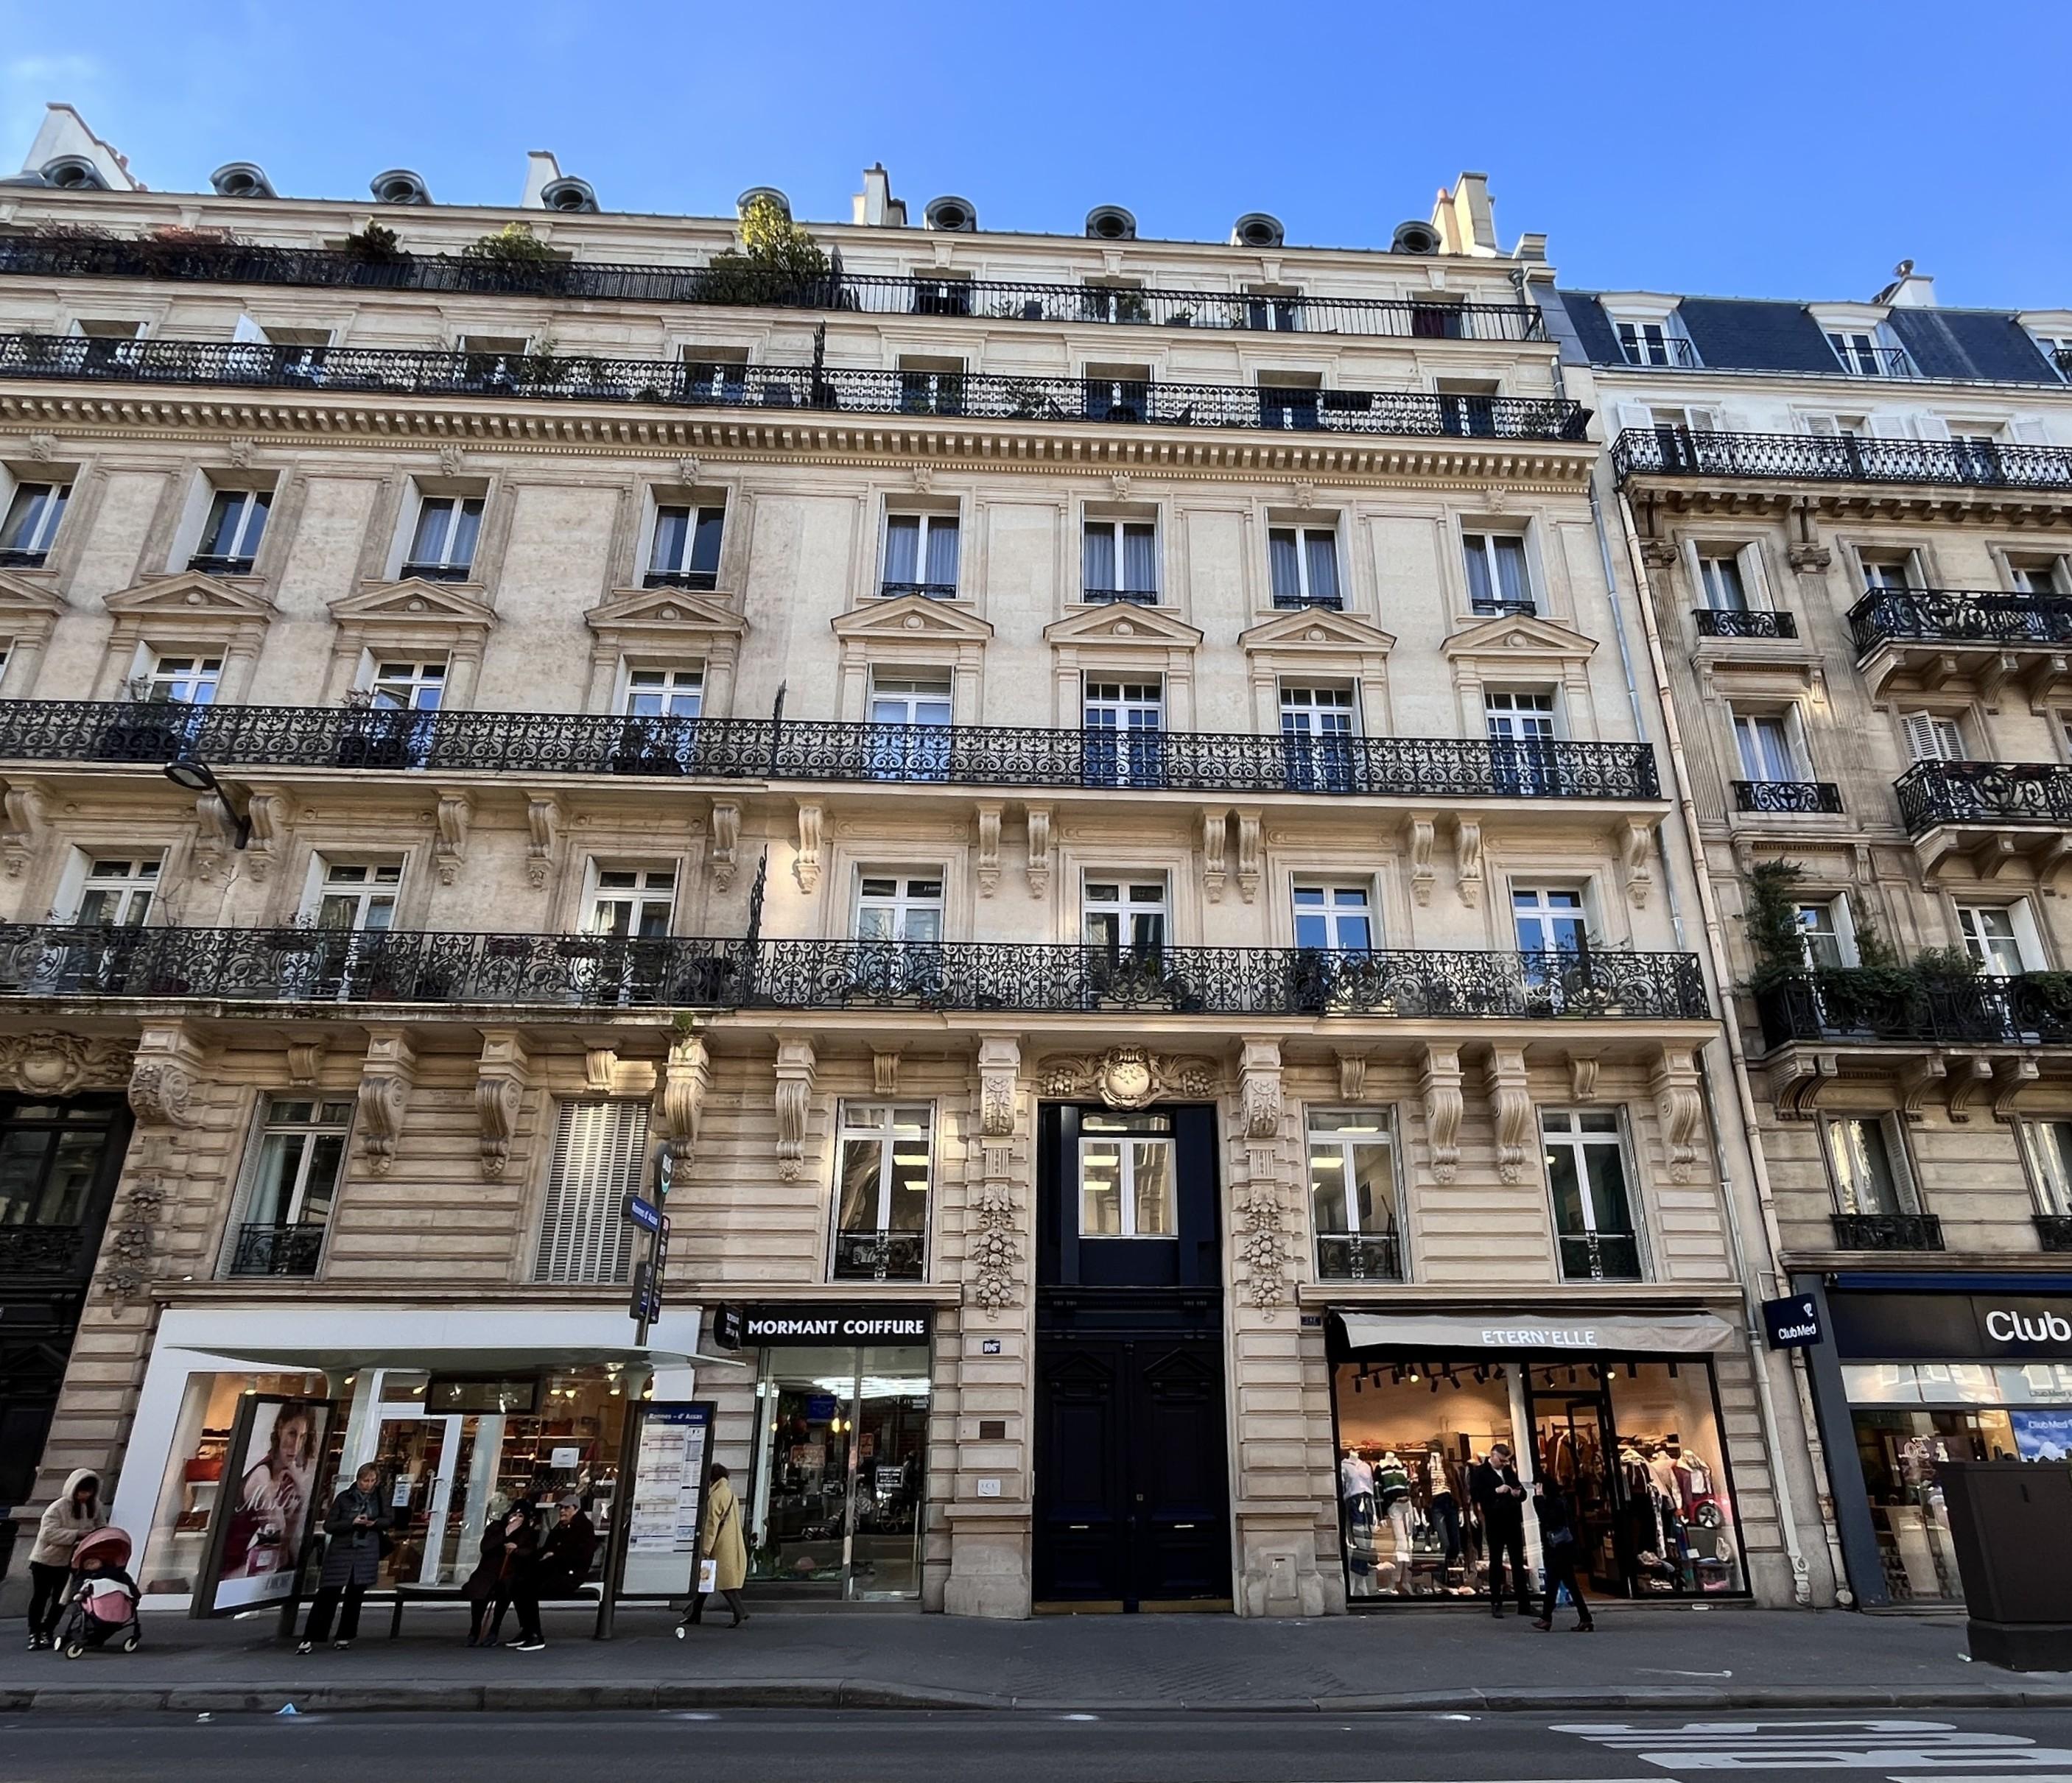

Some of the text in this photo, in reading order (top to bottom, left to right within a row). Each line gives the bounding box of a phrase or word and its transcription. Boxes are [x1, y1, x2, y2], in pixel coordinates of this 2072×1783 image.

[747, 1319, 839, 1335] MORMANT
[843, 1319, 924, 1335] COIFFURE
[1778, 1323, 1816, 1340] Club Med
[1985, 1310, 2072, 1342] Club
[1481, 1329, 1598, 1346] ETERN'ELLE
